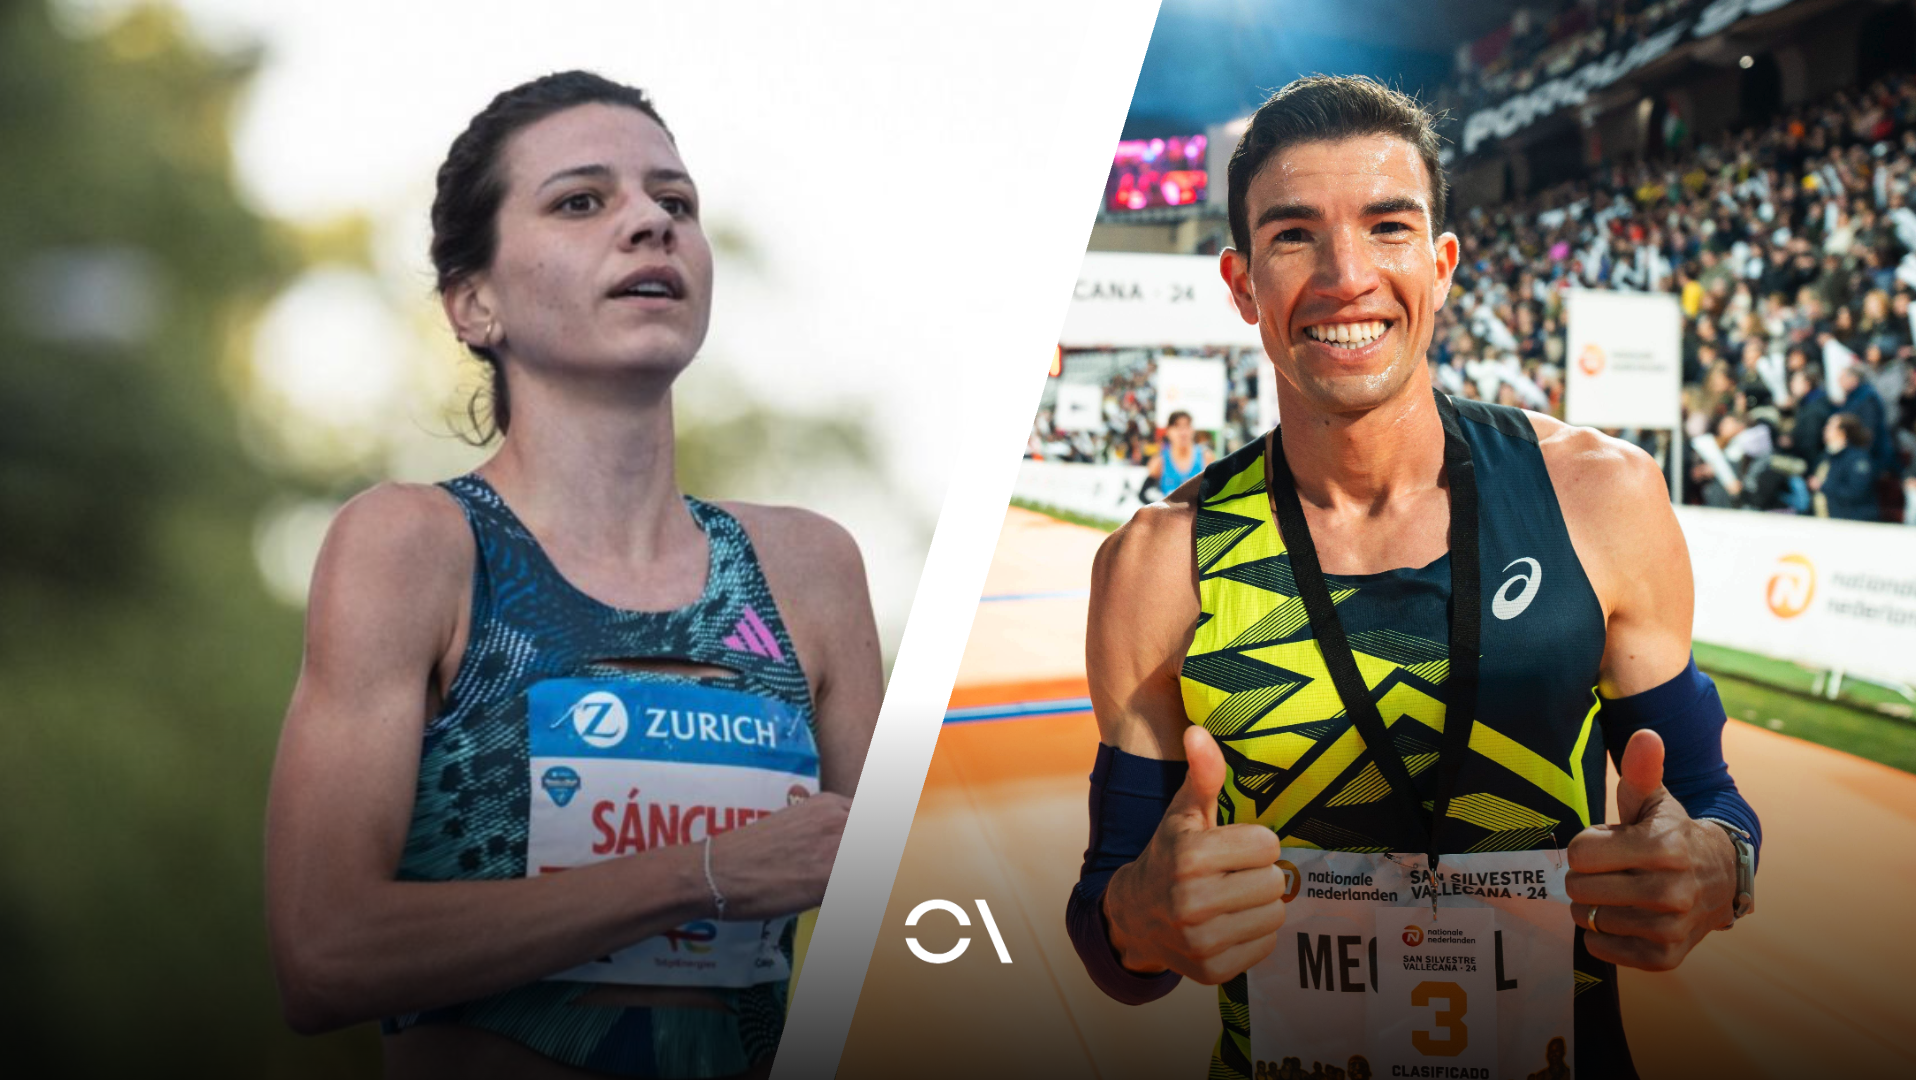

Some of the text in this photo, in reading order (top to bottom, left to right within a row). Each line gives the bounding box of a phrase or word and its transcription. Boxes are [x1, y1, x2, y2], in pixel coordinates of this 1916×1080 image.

[646, 708, 776, 749] ZURICH
[1307, 870, 1373, 887] nationale
[1450, 869, 1547, 887] SILVESTRE
[1307, 886, 1399, 902] nederlanden
[1526, 886, 1548, 900] 24
[1427, 928, 1464, 937] nationale
[1427, 936, 1476, 944] nederlanden
[1403, 955, 1476, 965] SAN SILVESTRE
[1403, 962, 1477, 972] VALLECANA 24
[1411, 981, 1468, 1057] 3
[1392, 1064, 1490, 1080] CLASIFICADO
